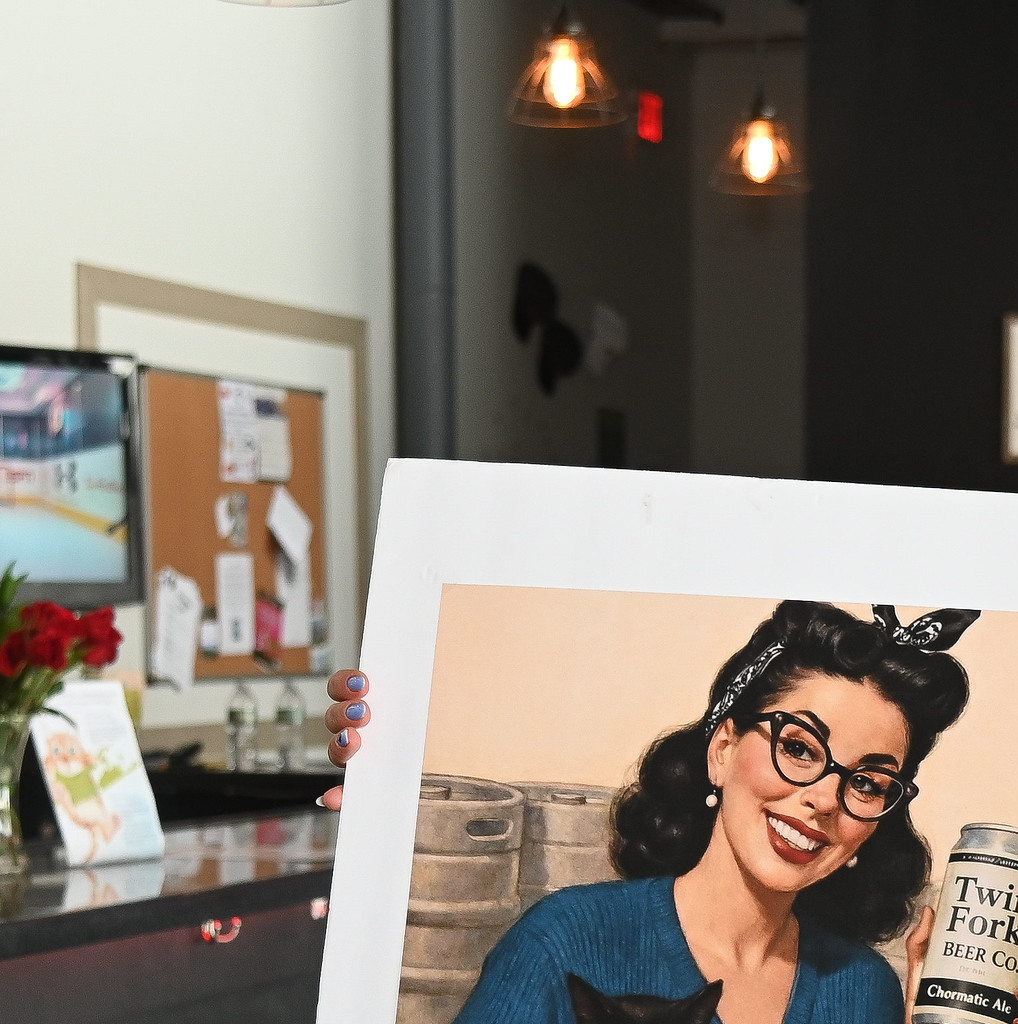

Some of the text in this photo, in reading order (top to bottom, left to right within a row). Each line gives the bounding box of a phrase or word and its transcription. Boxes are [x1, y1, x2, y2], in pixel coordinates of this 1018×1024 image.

[942, 941, 986, 963] BEER
[926, 983, 1012, 1015] Chormatic Ale
